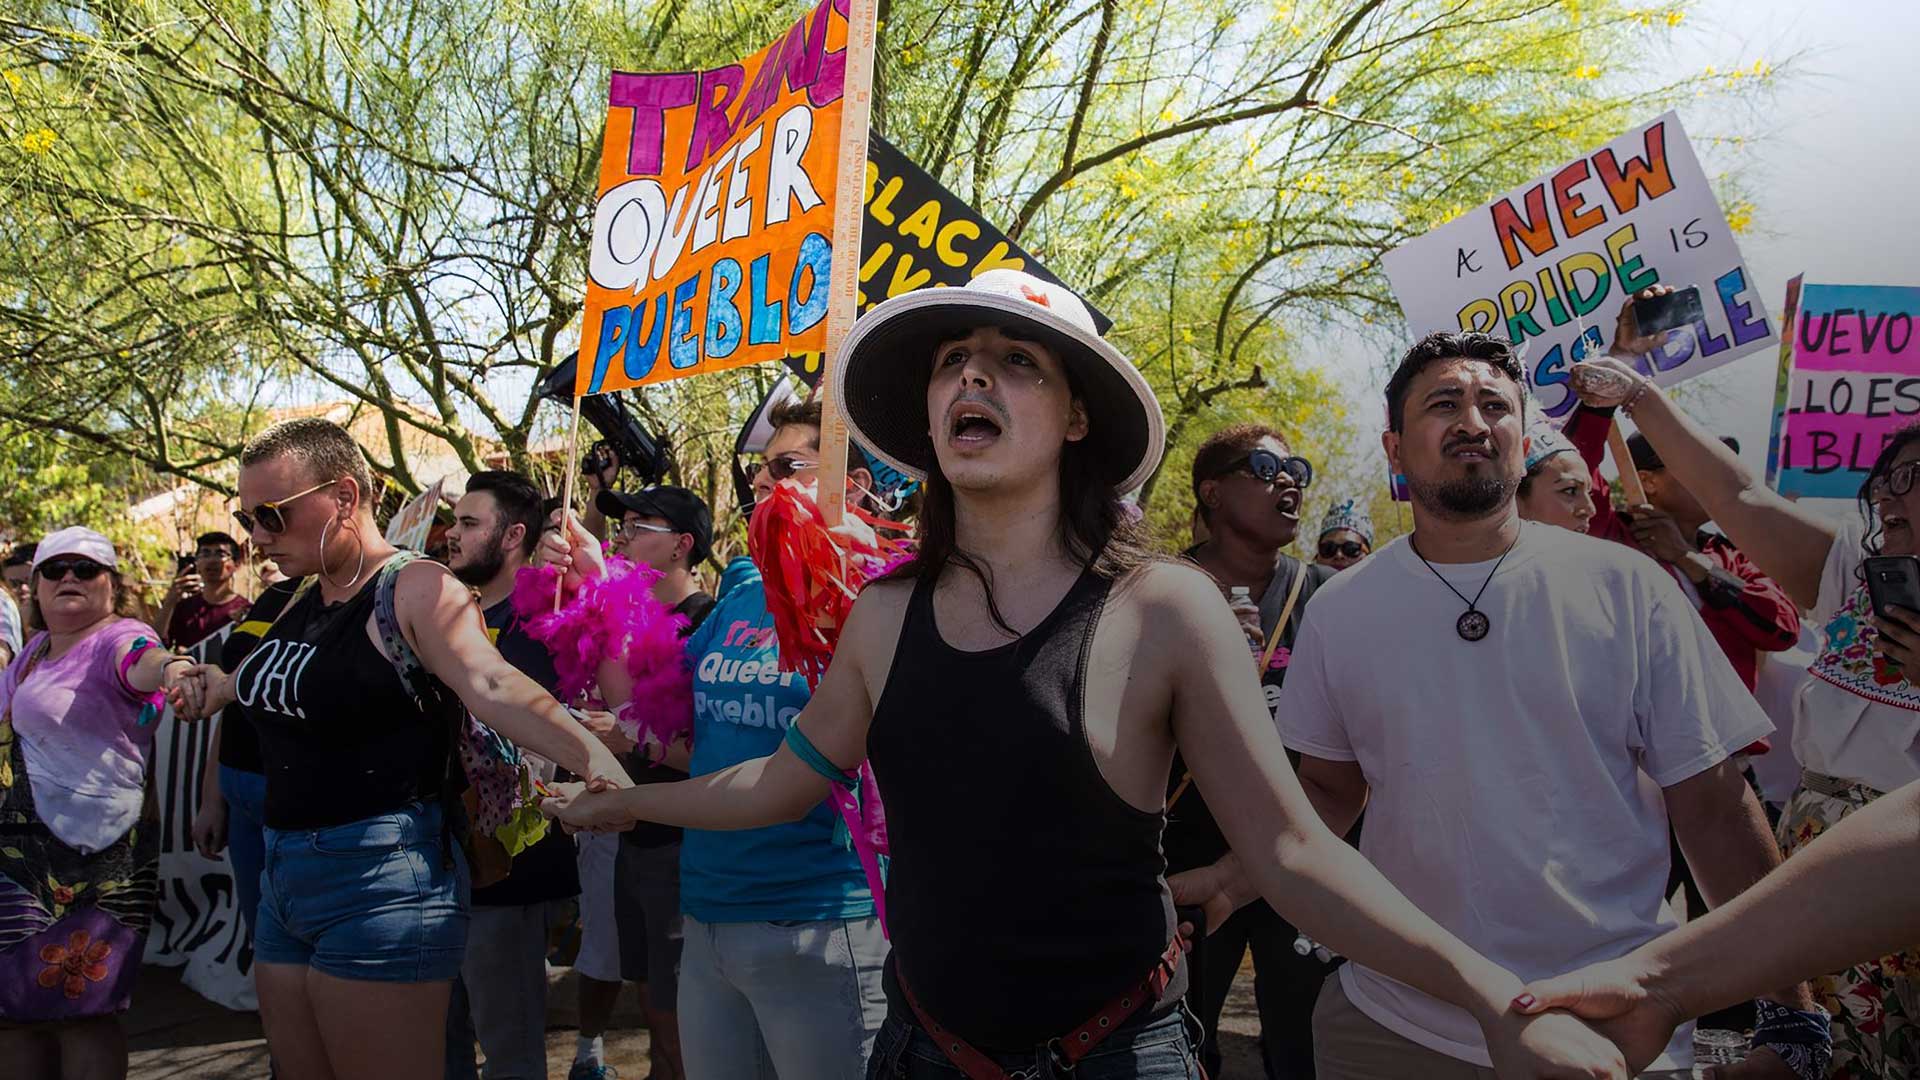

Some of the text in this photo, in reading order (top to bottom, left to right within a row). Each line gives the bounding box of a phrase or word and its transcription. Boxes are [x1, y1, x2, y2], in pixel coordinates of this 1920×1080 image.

[853, 144, 864, 183] PAINTS
[589, 105, 825, 296] QUEER
[1456, 121, 1676, 277] A NEW
[587, 232, 832, 394] PUEBLO
[1456, 218, 1709, 345] PRIDE IS
[1801, 308, 1912, 356] UEVO
[1778, 376, 1920, 417] LO ES
[1782, 430, 1895, 475] IBL
[236, 639, 317, 720] OH!
[694, 691, 803, 730] Pueblo
